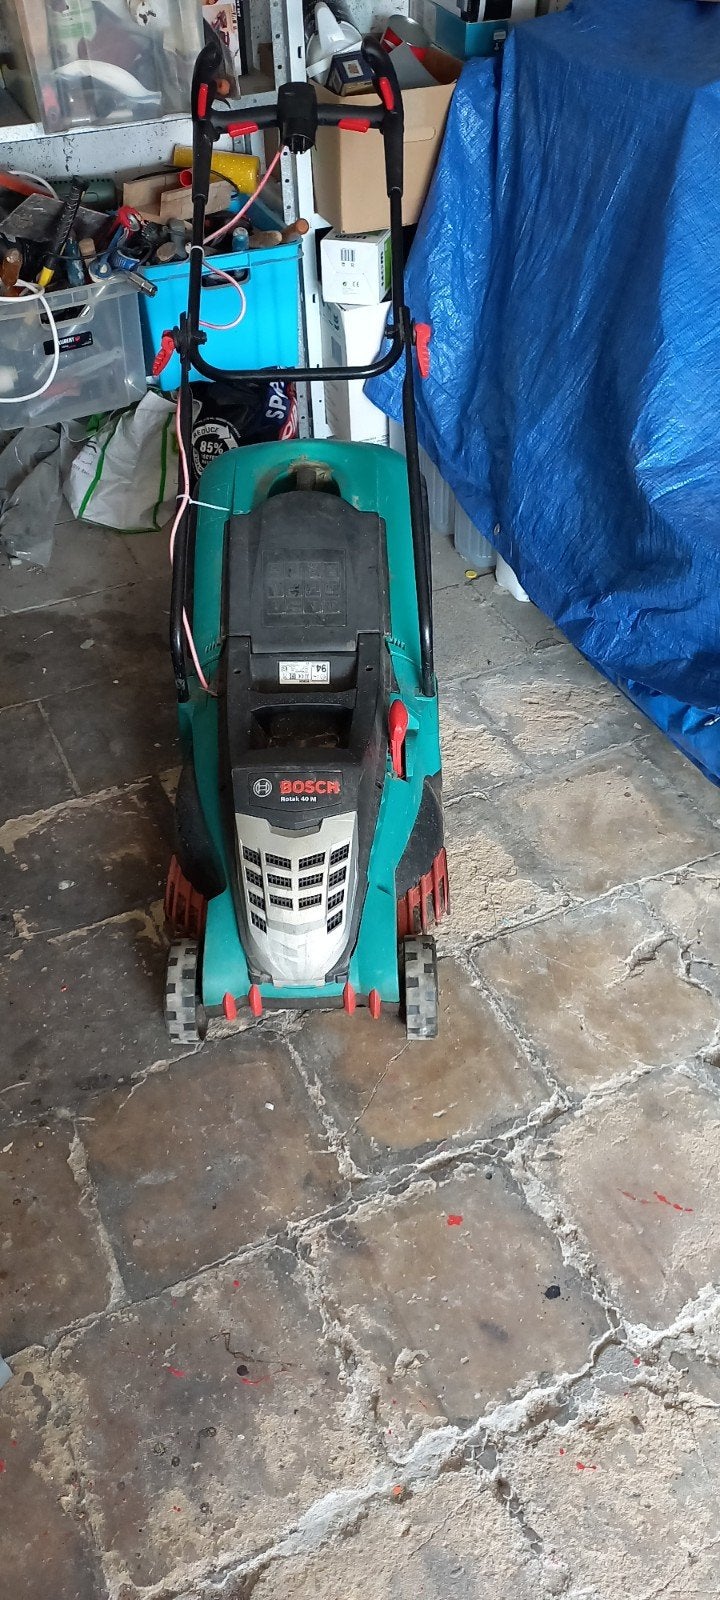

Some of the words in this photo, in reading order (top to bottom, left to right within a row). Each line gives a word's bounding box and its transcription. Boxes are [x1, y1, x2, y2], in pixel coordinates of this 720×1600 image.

[199, 440, 224, 454] 85%
[316, 664, 327, 673] 94
[279, 779, 341, 794] BOSCH
